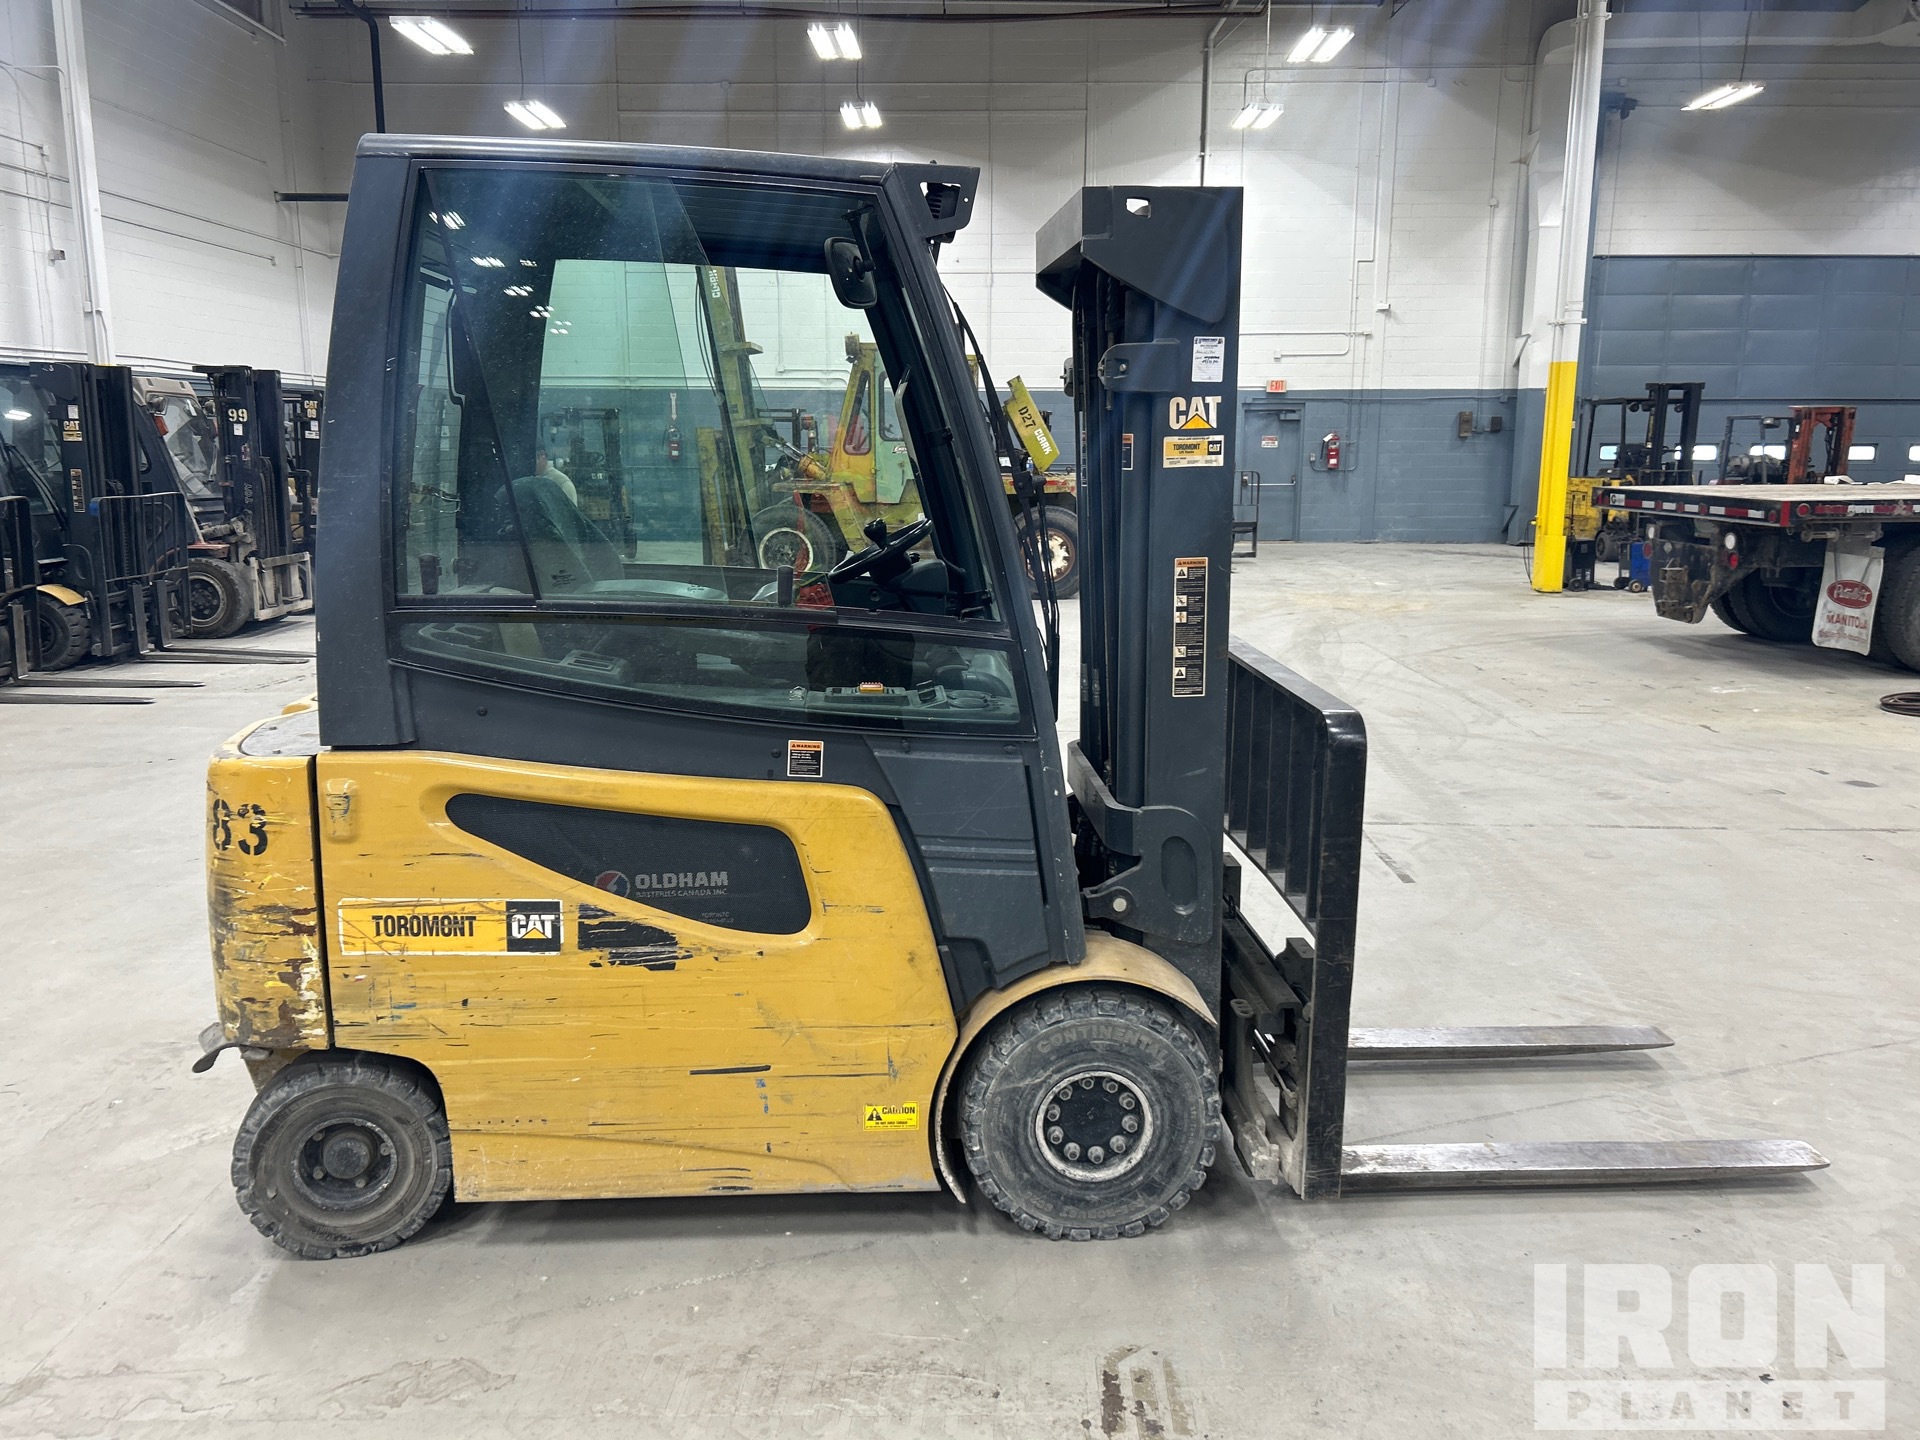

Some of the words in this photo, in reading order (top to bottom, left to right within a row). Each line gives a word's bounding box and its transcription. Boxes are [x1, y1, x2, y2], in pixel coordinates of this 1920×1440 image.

[1270, 380, 1285, 391] EXIT
[304, 400, 319, 409] CAT
[227, 408, 248, 423] 99
[306, 408, 317, 418] 09
[1018, 406, 1037, 429] D27
[1168, 395, 1222, 430] CAT
[63, 420, 80, 431] CAT
[1033, 428, 1053, 455] CLARK
[1173, 443, 1201, 451] TOROMONT
[1208, 443, 1221, 452] CAT
[213, 798, 269, 856] 83
[634, 871, 730, 889] OLDHAM
[678, 888, 711, 897] CANADA
[371, 914, 477, 938] TOROMONT
[511, 913, 556, 939] CAT
